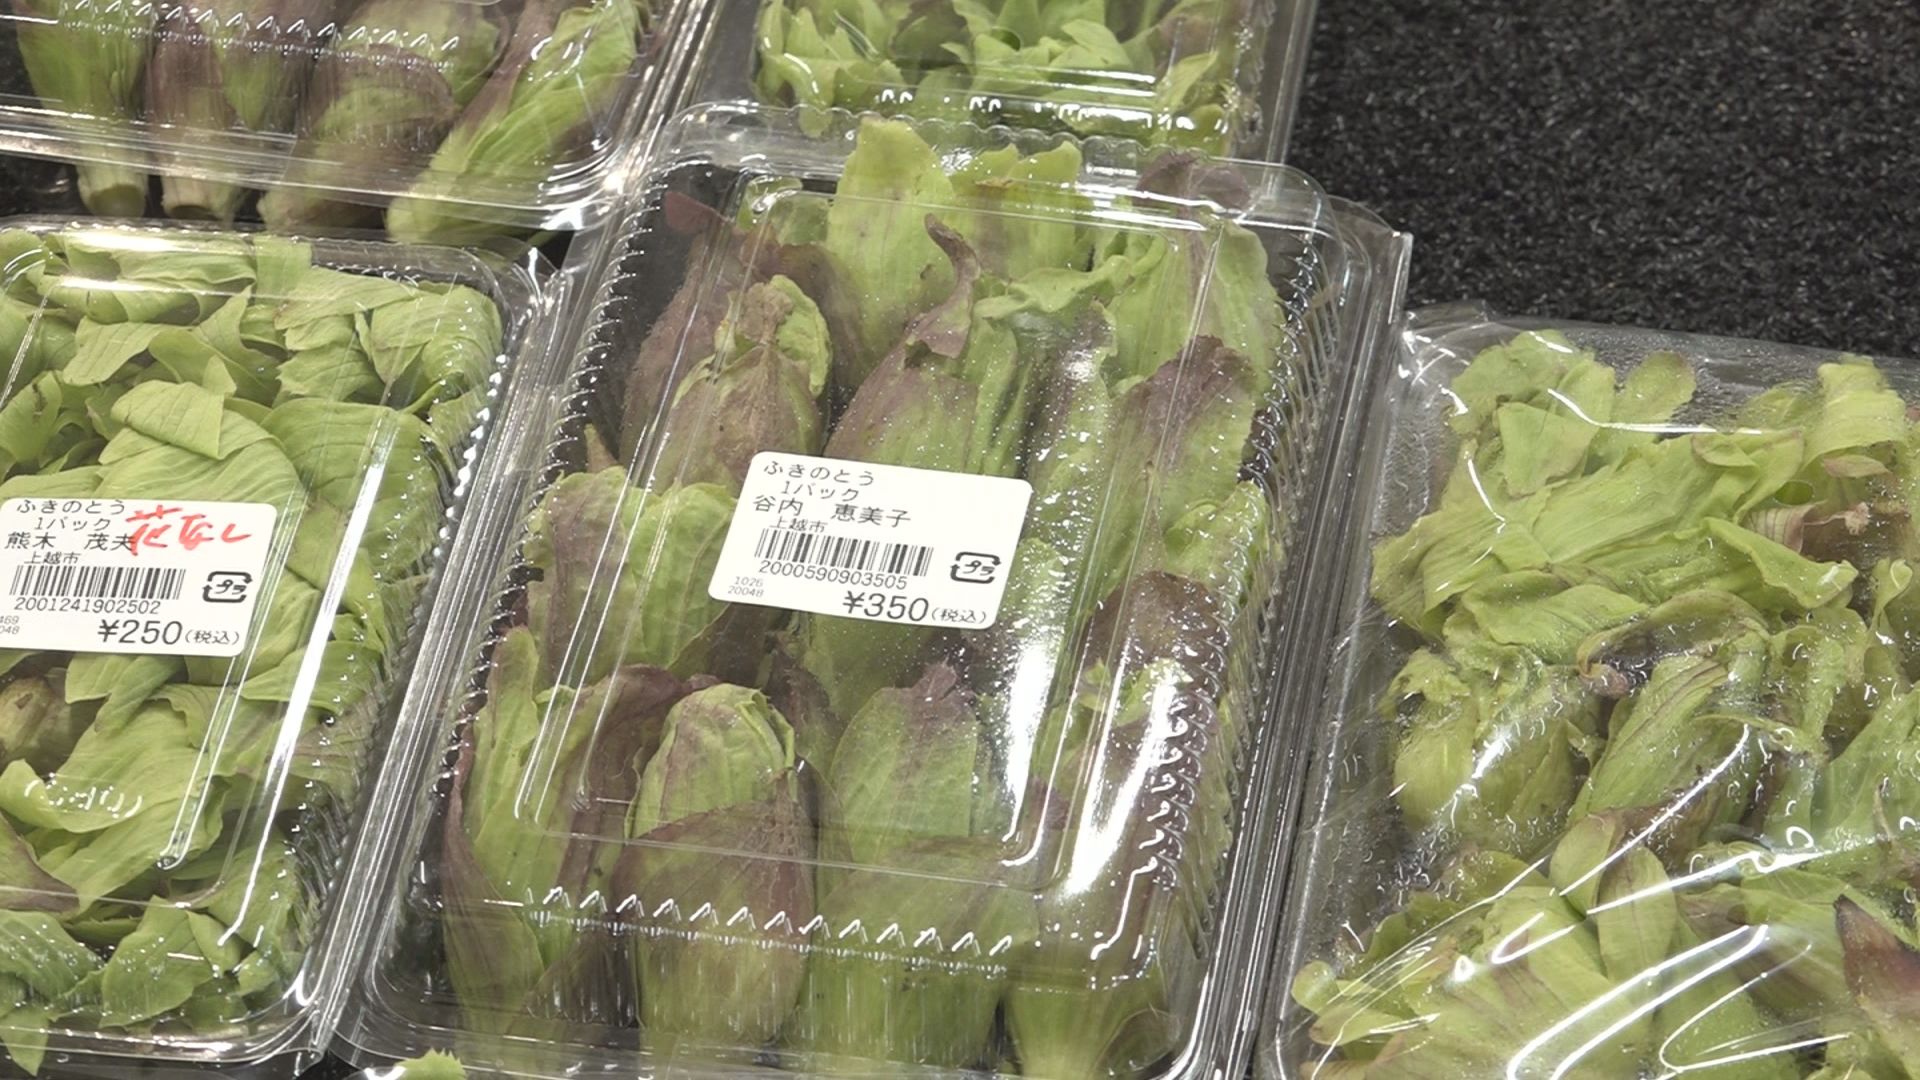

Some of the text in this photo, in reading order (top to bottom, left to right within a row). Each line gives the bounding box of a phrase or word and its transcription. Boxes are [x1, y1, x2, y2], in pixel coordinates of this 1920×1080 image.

[763, 460, 875, 486] ふきのとう
[16, 499, 126, 515] ふきのとう
[752, 494, 912, 528] 谷内 恵美子
[126, 504, 253, 557] 花なし
[769, 516, 829, 533] 上越市
[4, 531, 136, 552] 熊木 茂夫
[24, 551, 82, 565] 上越市
[758, 560, 908, 590] 2000590903505
[13, 597, 162, 614] 2001241902502
